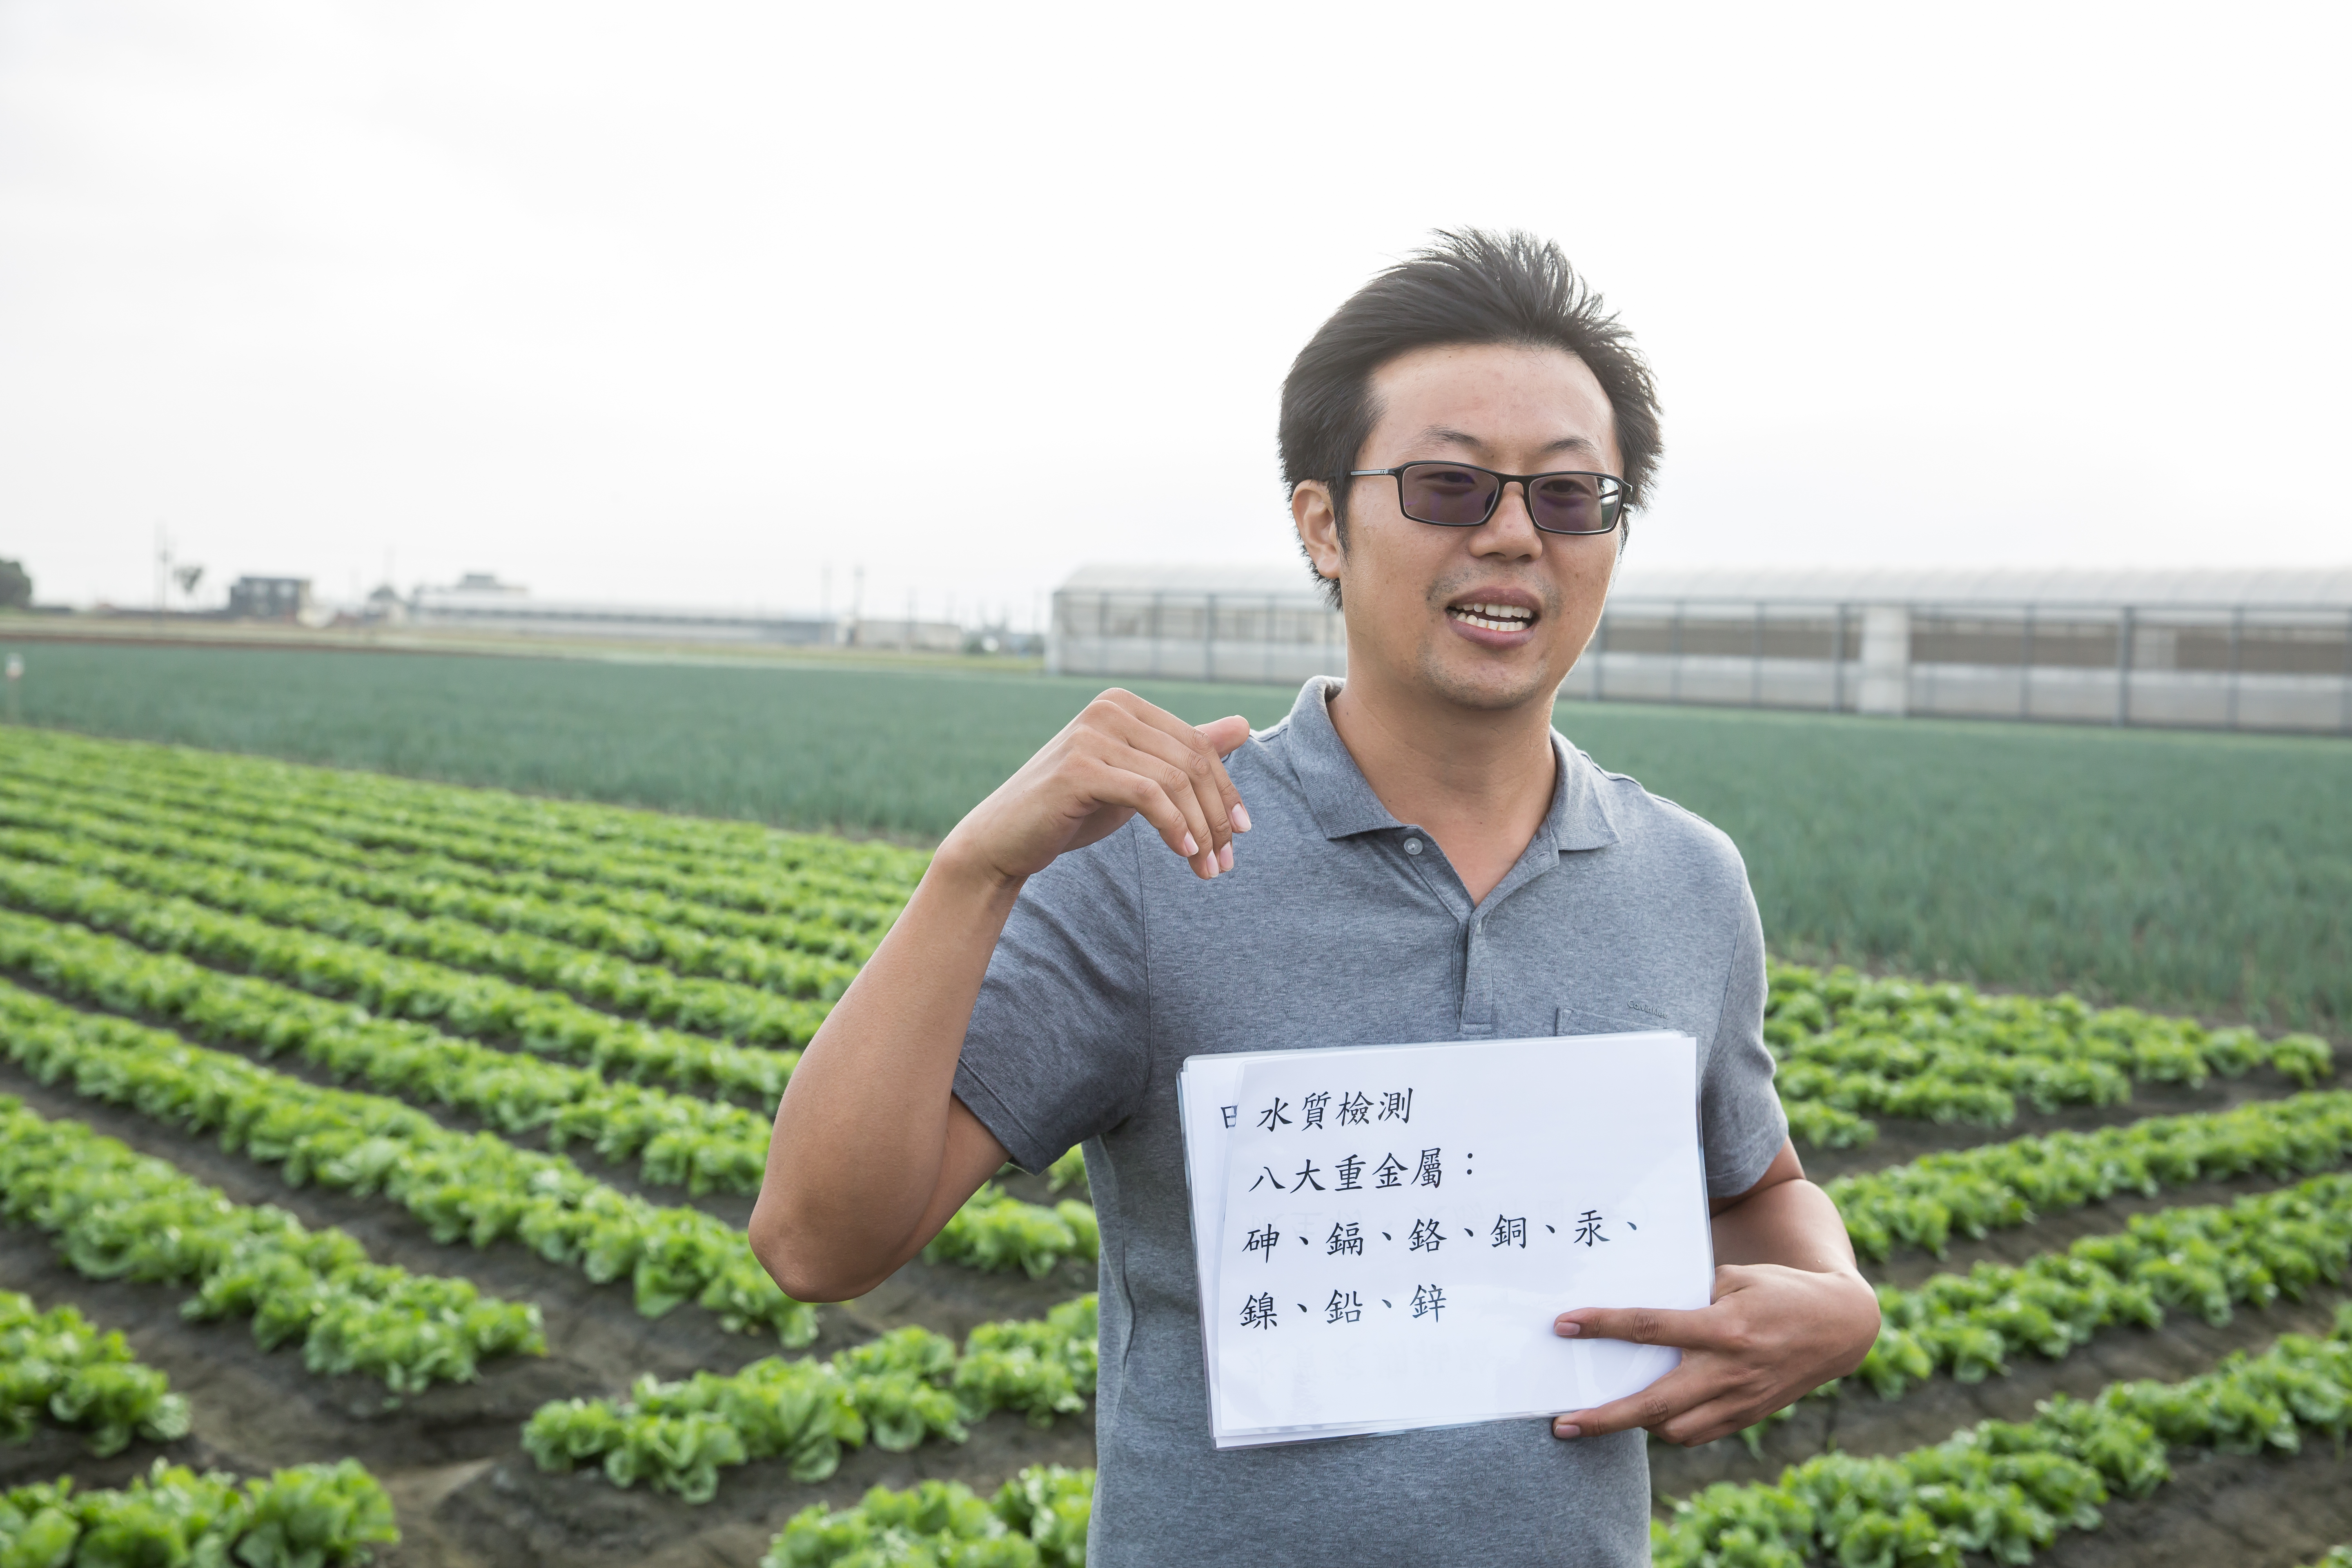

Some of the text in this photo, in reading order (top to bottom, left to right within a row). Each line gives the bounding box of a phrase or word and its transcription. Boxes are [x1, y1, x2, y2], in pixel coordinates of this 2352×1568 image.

[1627, 1000, 1669, 1020] Calvin Klein
[1256, 1087, 1414, 1133] 水質檢測
